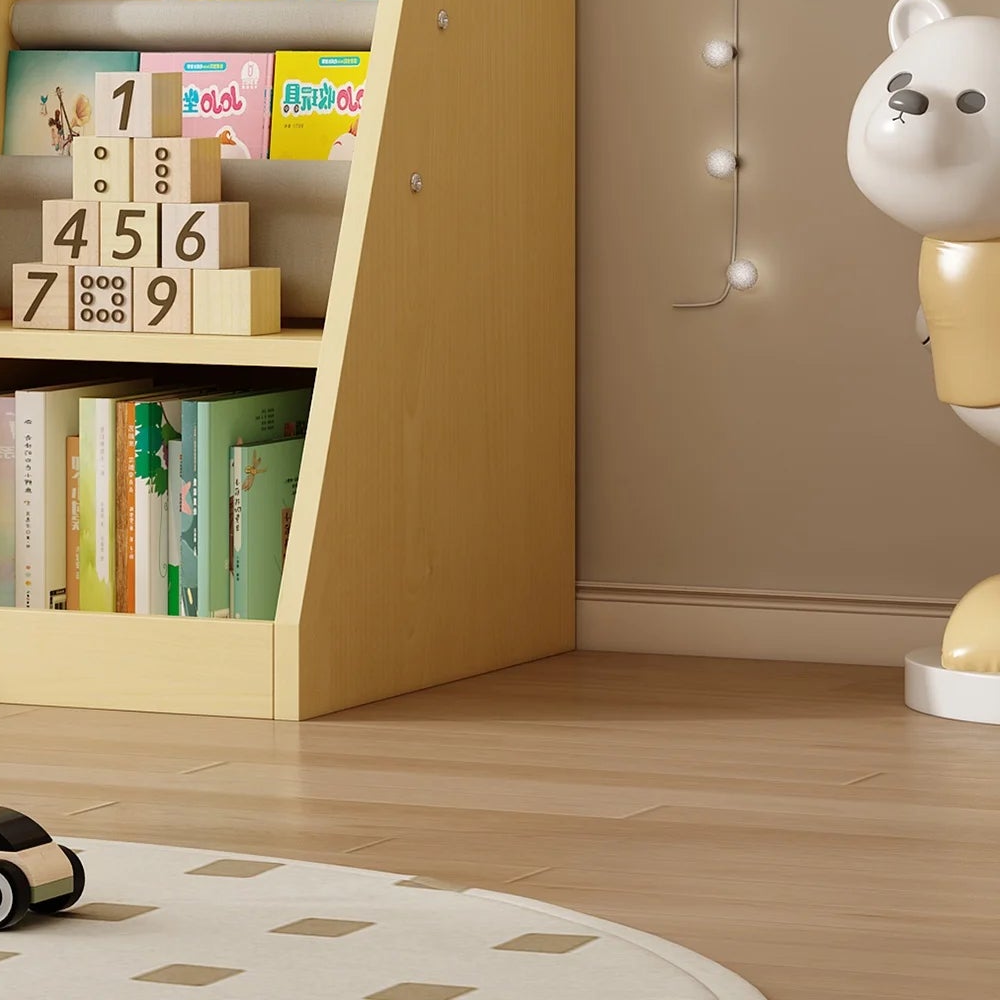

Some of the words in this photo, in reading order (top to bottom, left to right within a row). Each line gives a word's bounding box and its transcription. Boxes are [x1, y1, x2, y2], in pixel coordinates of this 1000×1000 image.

[111, 79, 135, 131] 1
[53, 208, 89, 259] 4
[111, 209, 146, 260] 5
[175, 210, 206, 262] 6
[23, 271, 58, 322] 7
[146, 275, 177, 326] 9
